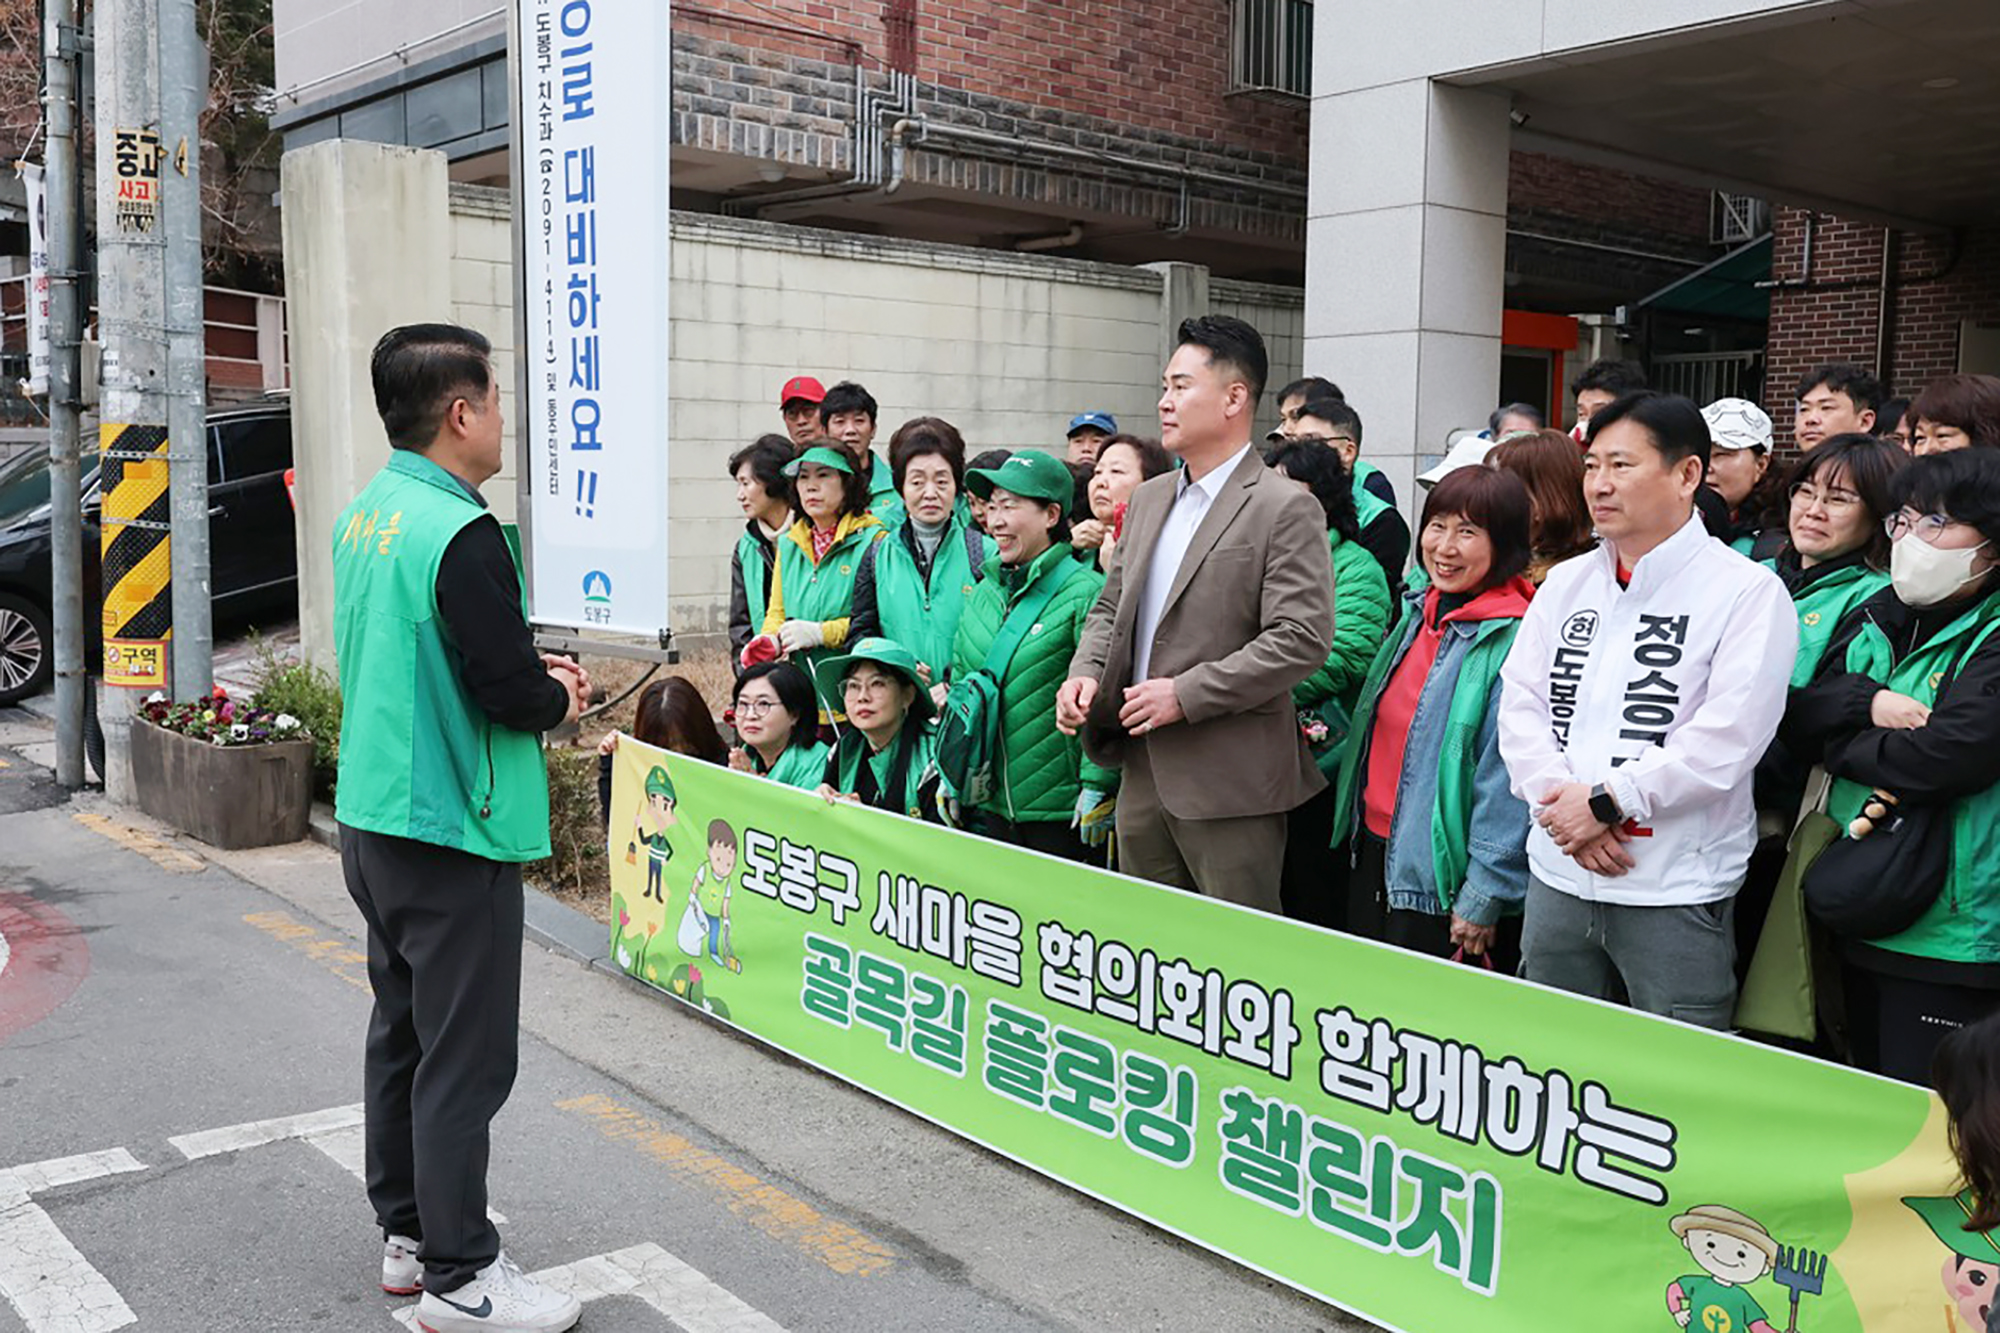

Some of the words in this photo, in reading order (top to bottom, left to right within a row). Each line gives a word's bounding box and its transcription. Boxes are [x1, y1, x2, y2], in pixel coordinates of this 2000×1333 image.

[536, 12, 552, 74] 도봉구
[560, 0, 595, 122] 으로
[564, 145, 602, 451] 대비하세요
[584, 606, 611, 625] 도봉구
[741, 827, 860, 926] 도봉구
[871, 871, 1023, 987] 새마을
[1038, 921, 1300, 1080] 협의회와
[1314, 1005, 1677, 1206] 함께하는
[801, 930, 968, 1078] 골목길
[983, 997, 1199, 1169] 플로킹
[1217, 1085, 1502, 1297] 챌린지
